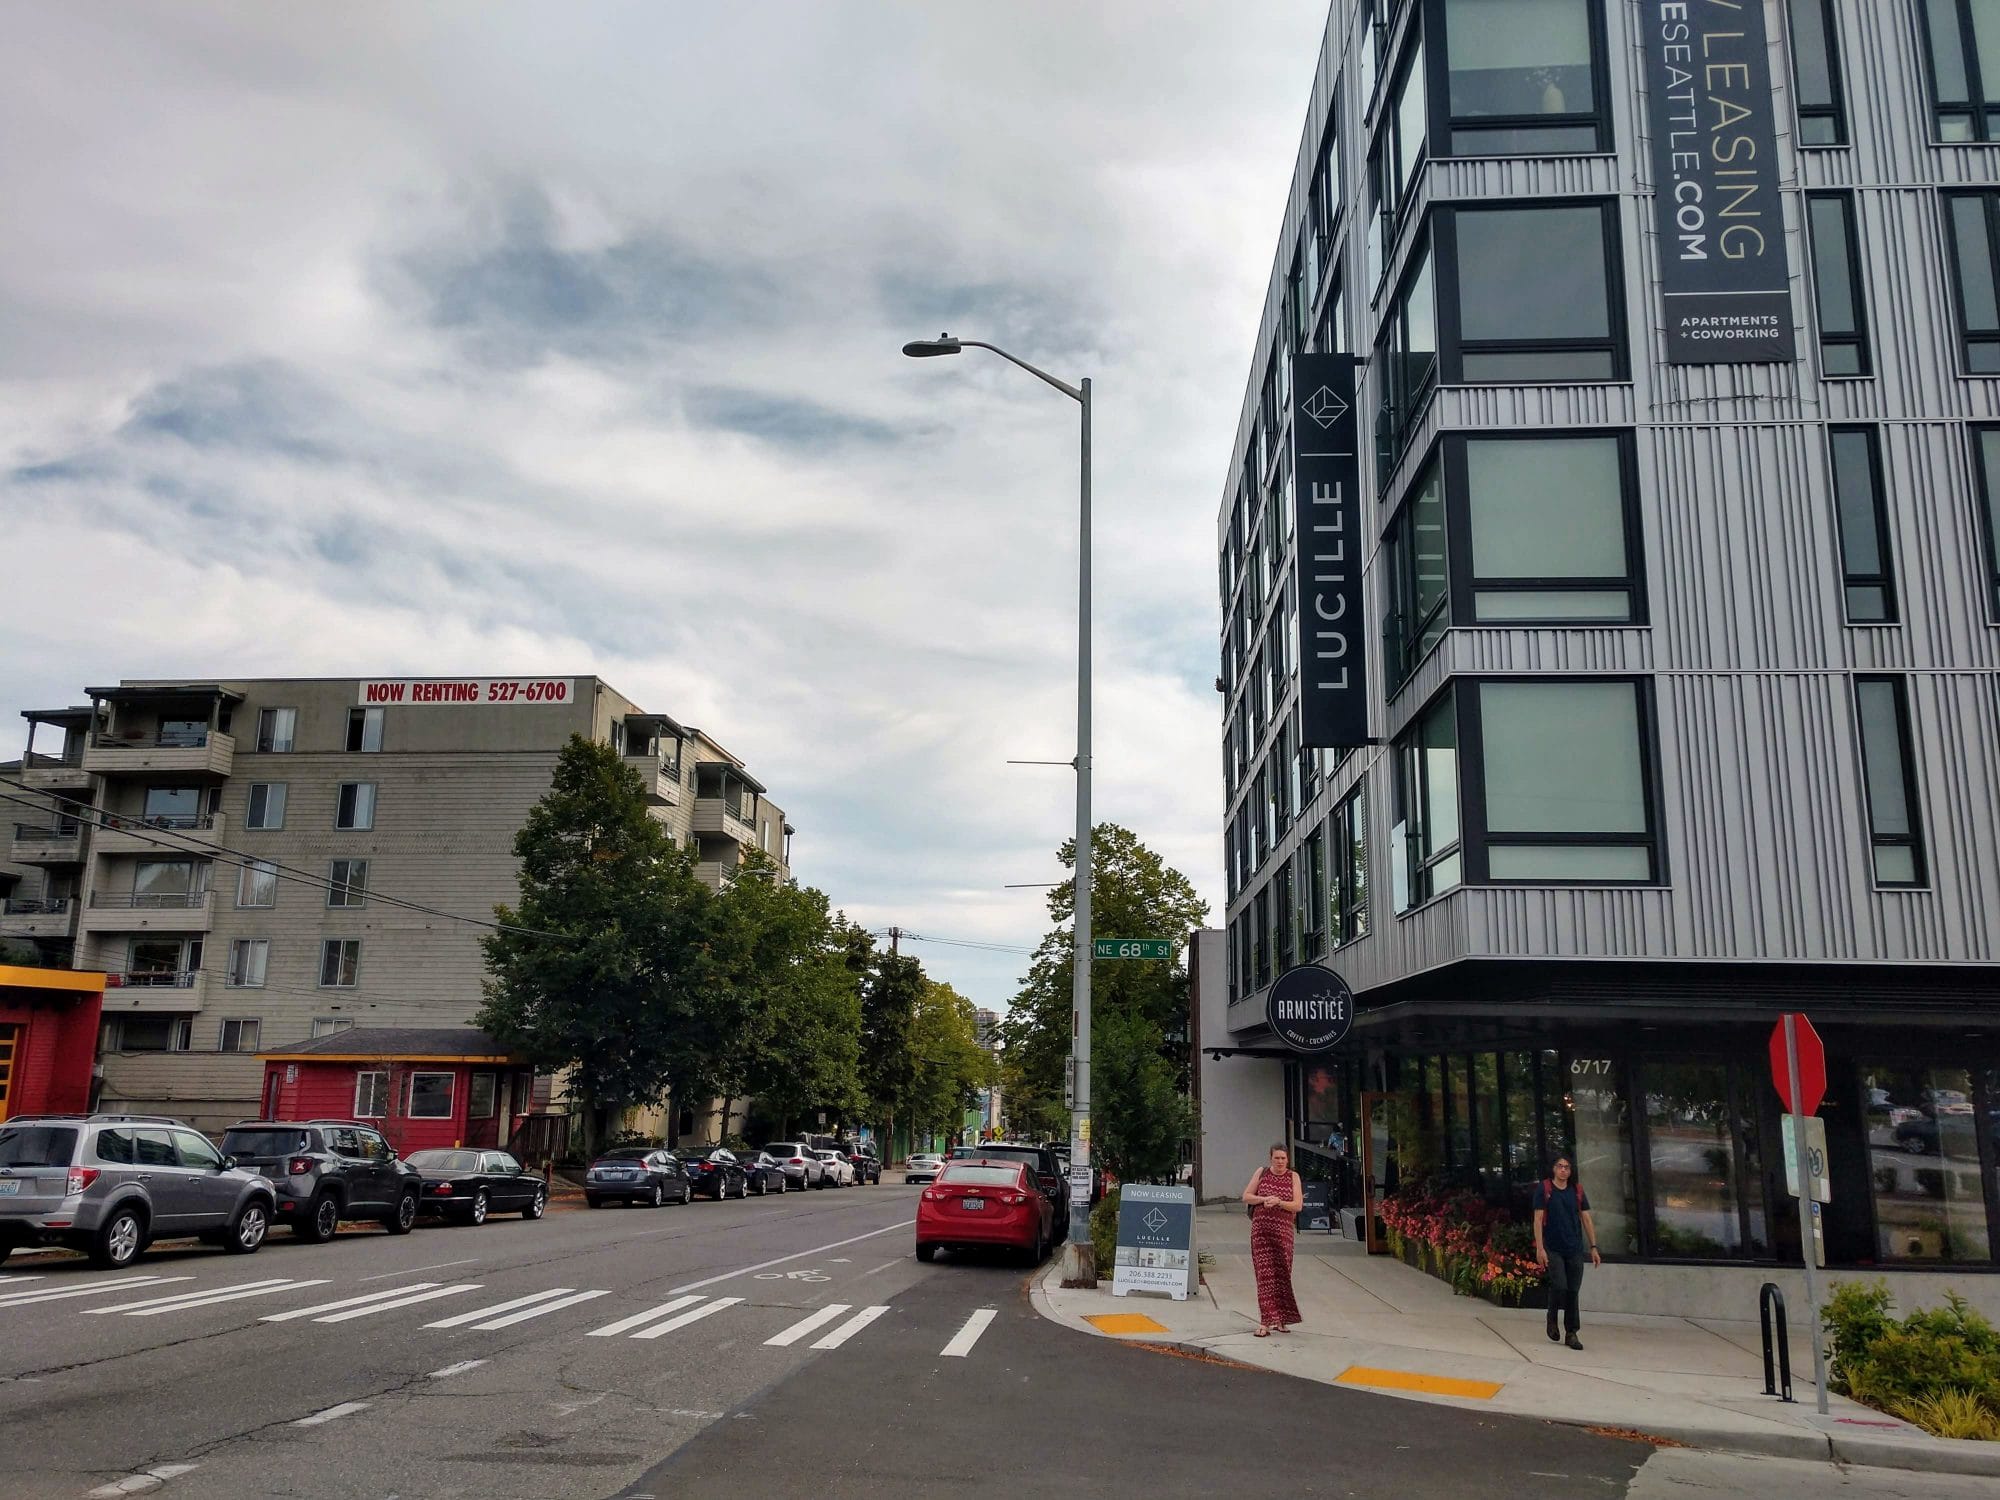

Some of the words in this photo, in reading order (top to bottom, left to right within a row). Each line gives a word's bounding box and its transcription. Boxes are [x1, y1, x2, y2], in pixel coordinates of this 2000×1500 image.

[1703, 32, 1765, 259] LEASING
[1680, 315, 1778, 327] APARTMENTS
[1691, 328, 1779, 340] COWORKING
[1312, 481, 1349, 690] LUCILLE
[366, 683, 406, 702] NOW
[412, 683, 479, 702] RENTING
[488, 681, 567, 701] 527-6700
[1097, 944, 1113, 955] NE
[1157, 945, 1168, 956] St
[1278, 1000, 1344, 1020] ARMISTICE
[1570, 1059, 1612, 1075] 6717
[1131, 1190, 1149, 1198] NOW
[1151, 1191, 1183, 1199] LEASING
